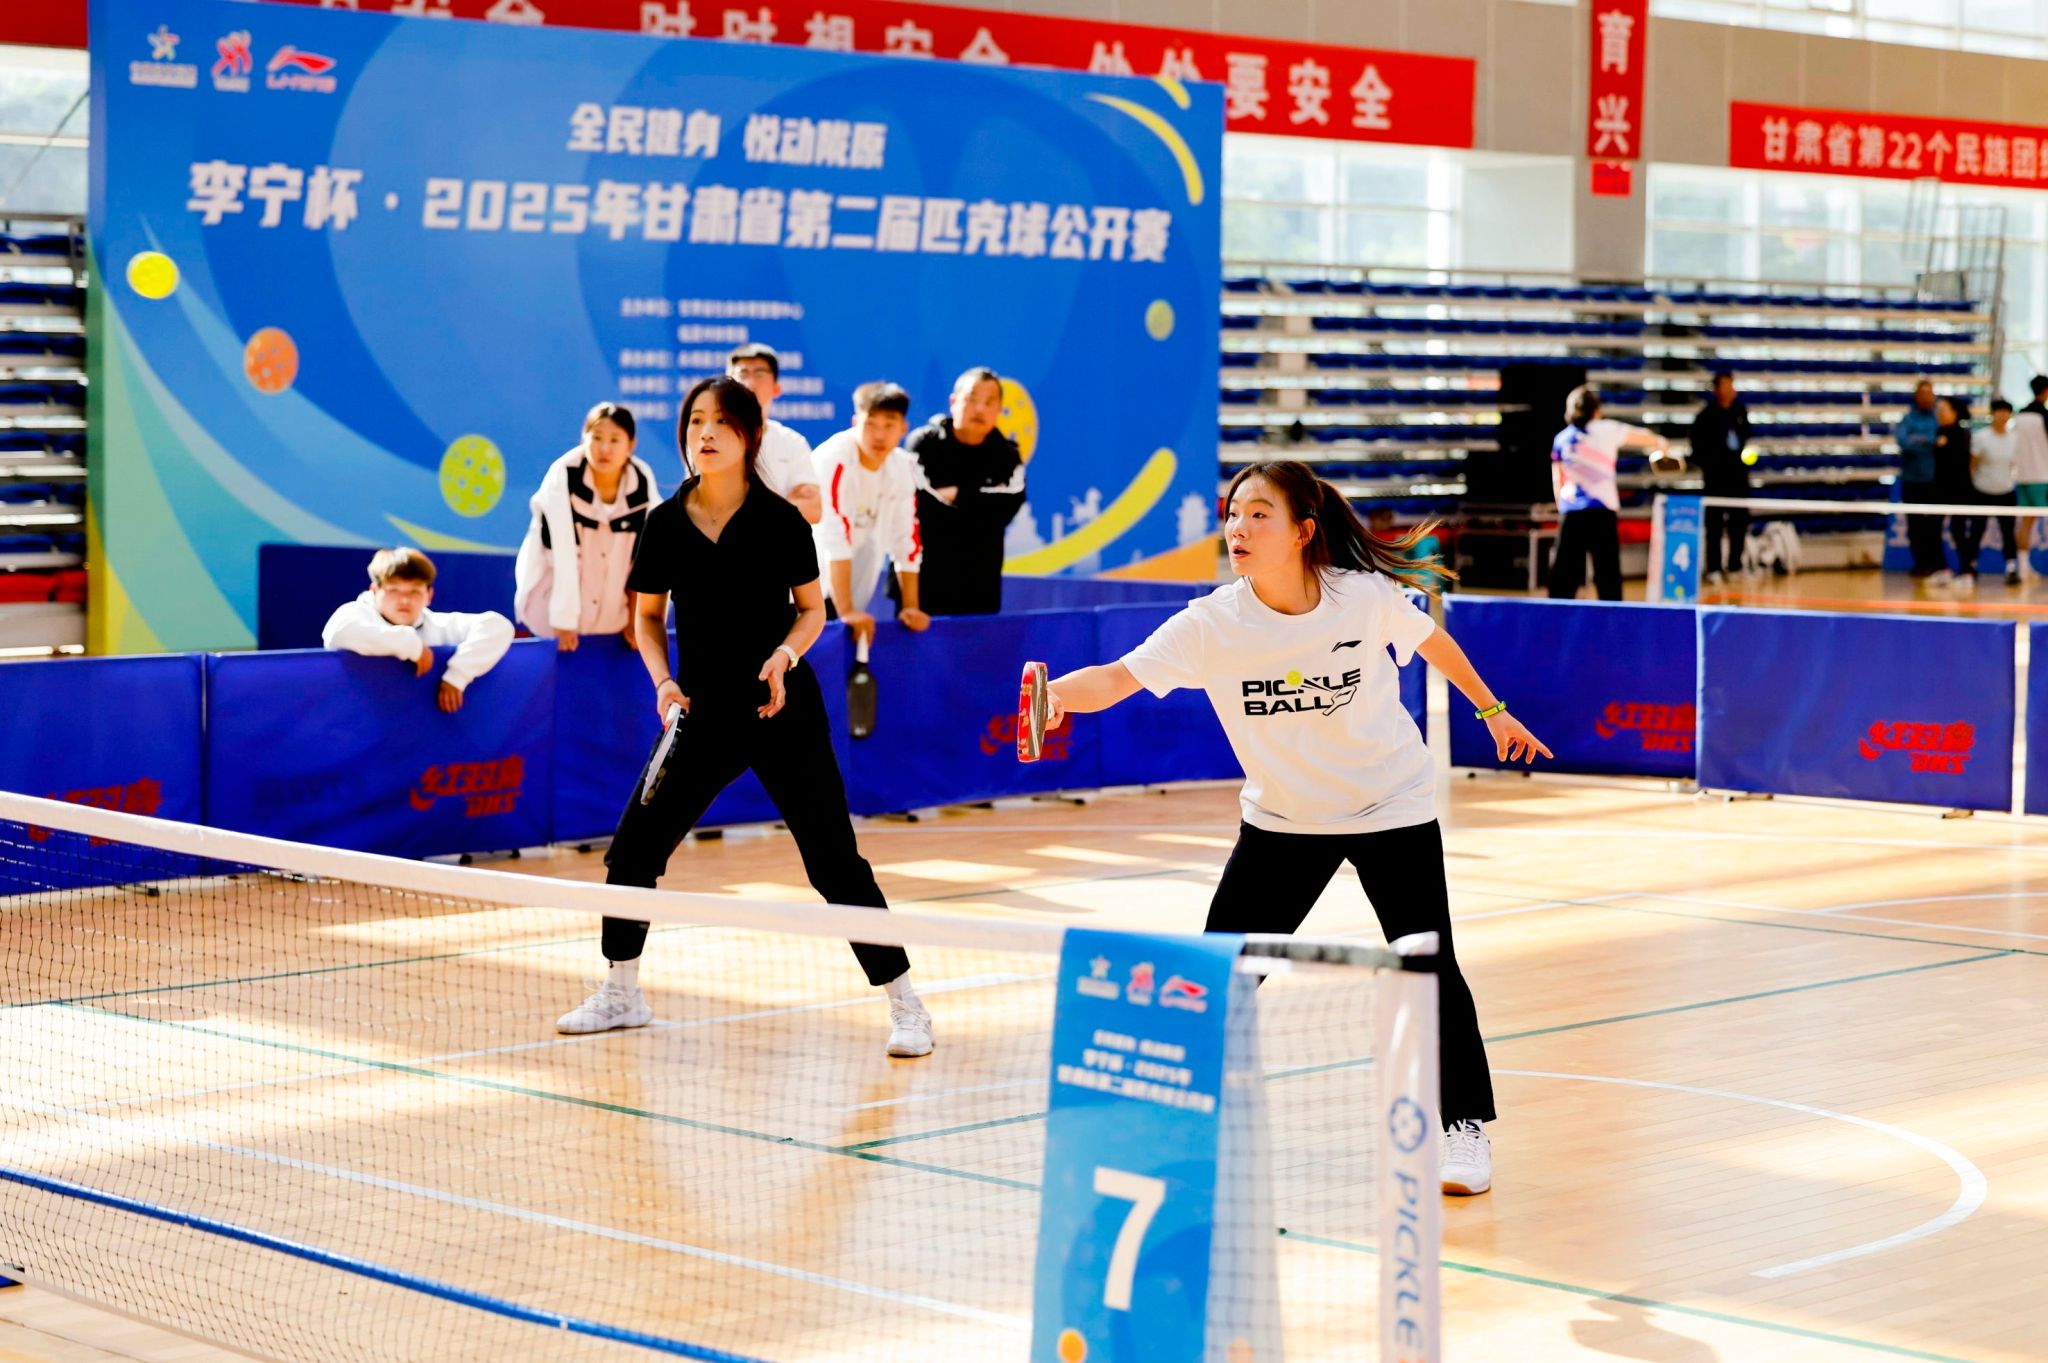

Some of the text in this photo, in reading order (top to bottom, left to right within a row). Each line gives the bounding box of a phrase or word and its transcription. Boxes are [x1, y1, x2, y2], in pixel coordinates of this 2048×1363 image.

[567, 102, 721, 158] 全民健身
[1762, 114, 2048, 181] 甘肃省第22个民族团
[1244, 696, 1333, 715] BALL
[1093, 1166, 1166, 1312] 7
[1394, 1170, 1424, 1351] PICKLE
